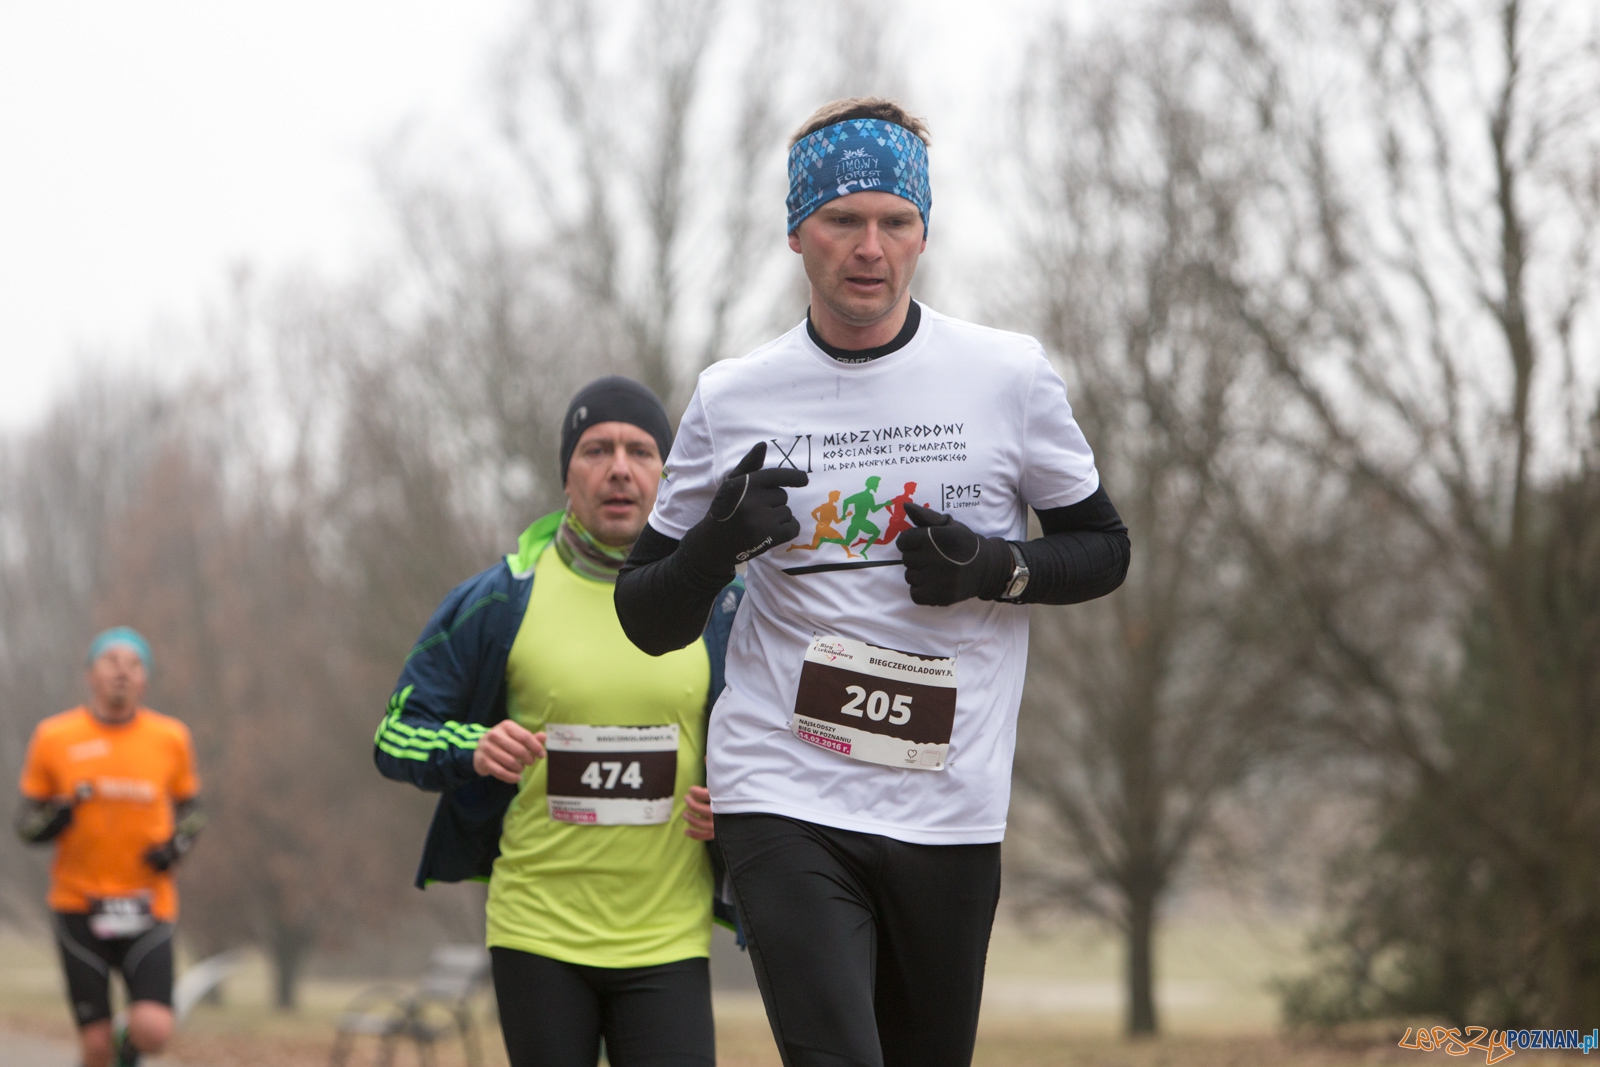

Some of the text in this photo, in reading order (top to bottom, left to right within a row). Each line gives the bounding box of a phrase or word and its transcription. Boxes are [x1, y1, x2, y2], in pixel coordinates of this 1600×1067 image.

[835, 158, 879, 176] ZIMOWY
[837, 170, 881, 184] FOREST
[836, 177, 881, 196] run
[823, 423, 964, 447] MIĘDZYNARODOWY
[770, 434, 812, 473] XI
[823, 442, 966, 459] KOŚCIAŃSKI PÓŁMARATON
[840, 462, 856, 470] DRA
[859, 458, 897, 468] HENRYKA
[900, 454, 967, 464] FLORKOWSKIEGO
[946, 484, 981, 499] 2015
[869, 657, 953, 676] BIEGCZEKOLADOWY.PL
[841, 685, 913, 726] 205
[799, 719, 836, 732] NAJSŁODSZY
[799, 732, 842, 750] 14.02.2016
[820, 732, 852, 743] POZNANIU
[580, 761, 643, 789] 474
